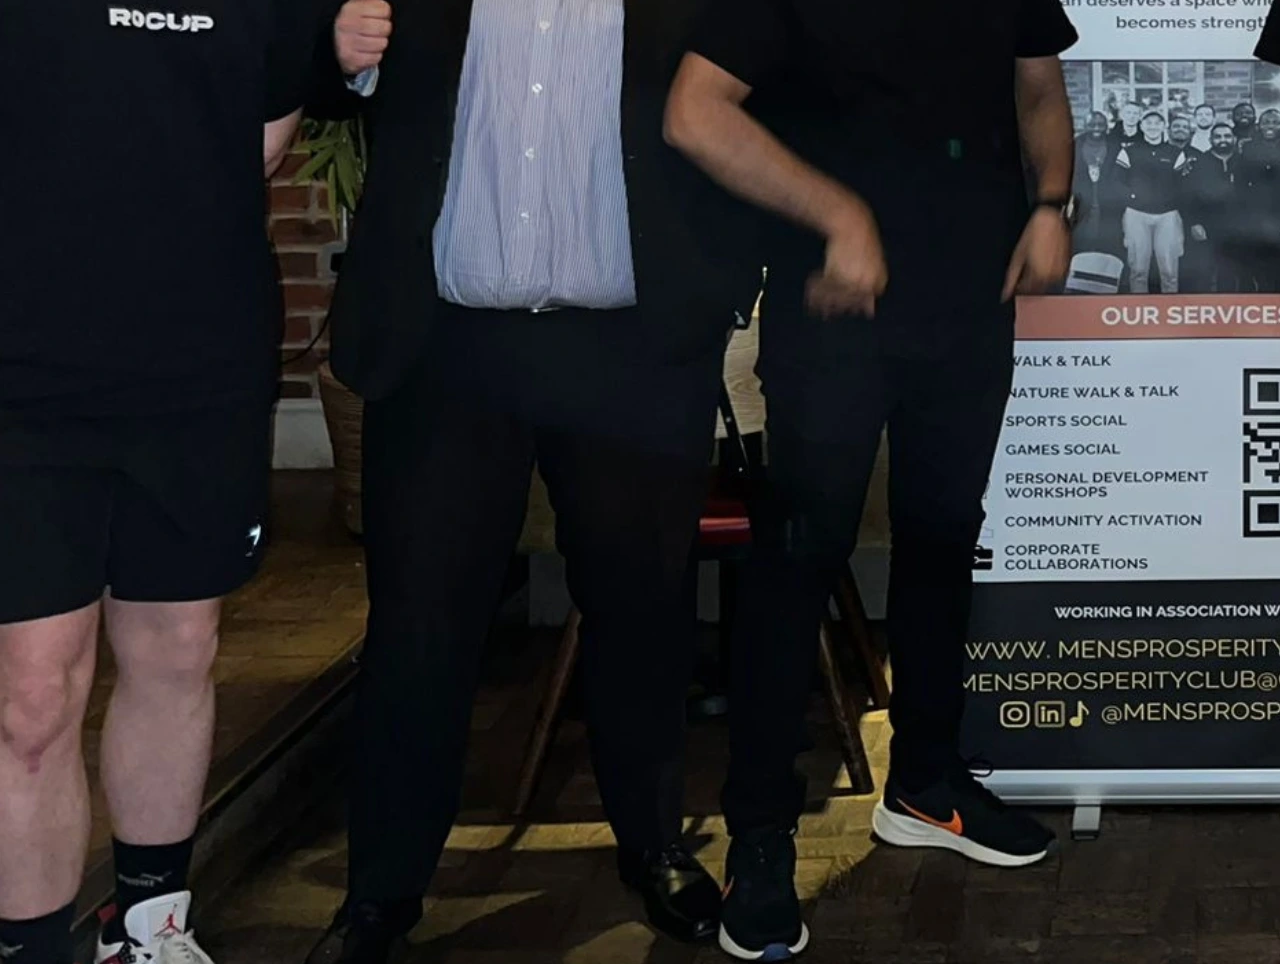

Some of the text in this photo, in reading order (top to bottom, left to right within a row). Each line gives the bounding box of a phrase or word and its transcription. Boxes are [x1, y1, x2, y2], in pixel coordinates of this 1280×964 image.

[1116, 16, 1197, 29] becomes
[1101, 306, 1160, 325] OUR
[1056, 355, 1067, 367] &
[1071, 355, 1111, 367] TALK
[1074, 386, 1121, 398] WALK
[1124, 386, 1135, 398] &
[1139, 385, 1179, 397] TALK
[1005, 415, 1127, 427] SPORTS SOCIAL
[1005, 443, 1120, 456] GAMES SOCIAL
[1005, 471, 1209, 485] PERSONAL DEVELOPMENT
[1004, 486, 1108, 499] WORKSHOPS
[1005, 514, 1202, 528] COMMUNITY ACTIVATION
[1005, 543, 1100, 556] CORPORATE
[1005, 557, 1149, 571] COLLABORATIONS
[1054, 605, 1133, 619] WORKING
[1136, 605, 1153, 618] IN
[1155, 604, 1261, 618] ASSOCIATION
[965, 640, 1051, 661] WWW.
